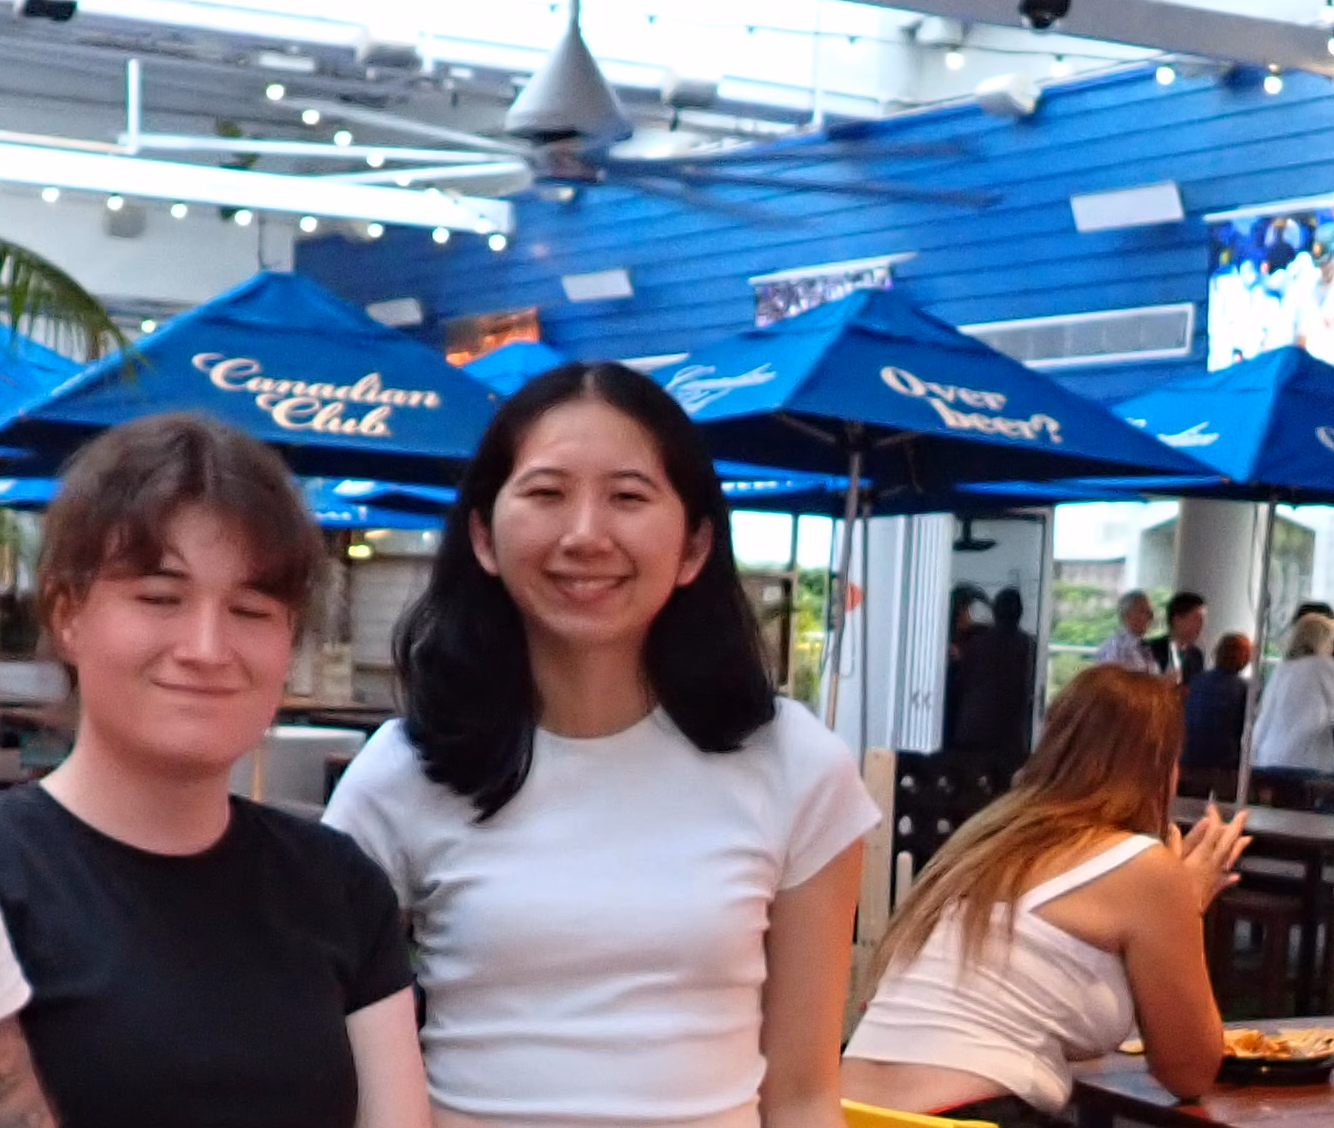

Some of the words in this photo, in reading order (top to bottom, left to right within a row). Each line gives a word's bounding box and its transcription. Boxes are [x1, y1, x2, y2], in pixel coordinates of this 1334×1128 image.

[191, 352, 441, 408] Canadian
[879, 366, 1008, 411] Over
[255, 392, 392, 437] Club
[926, 396, 1063, 444] beer?
